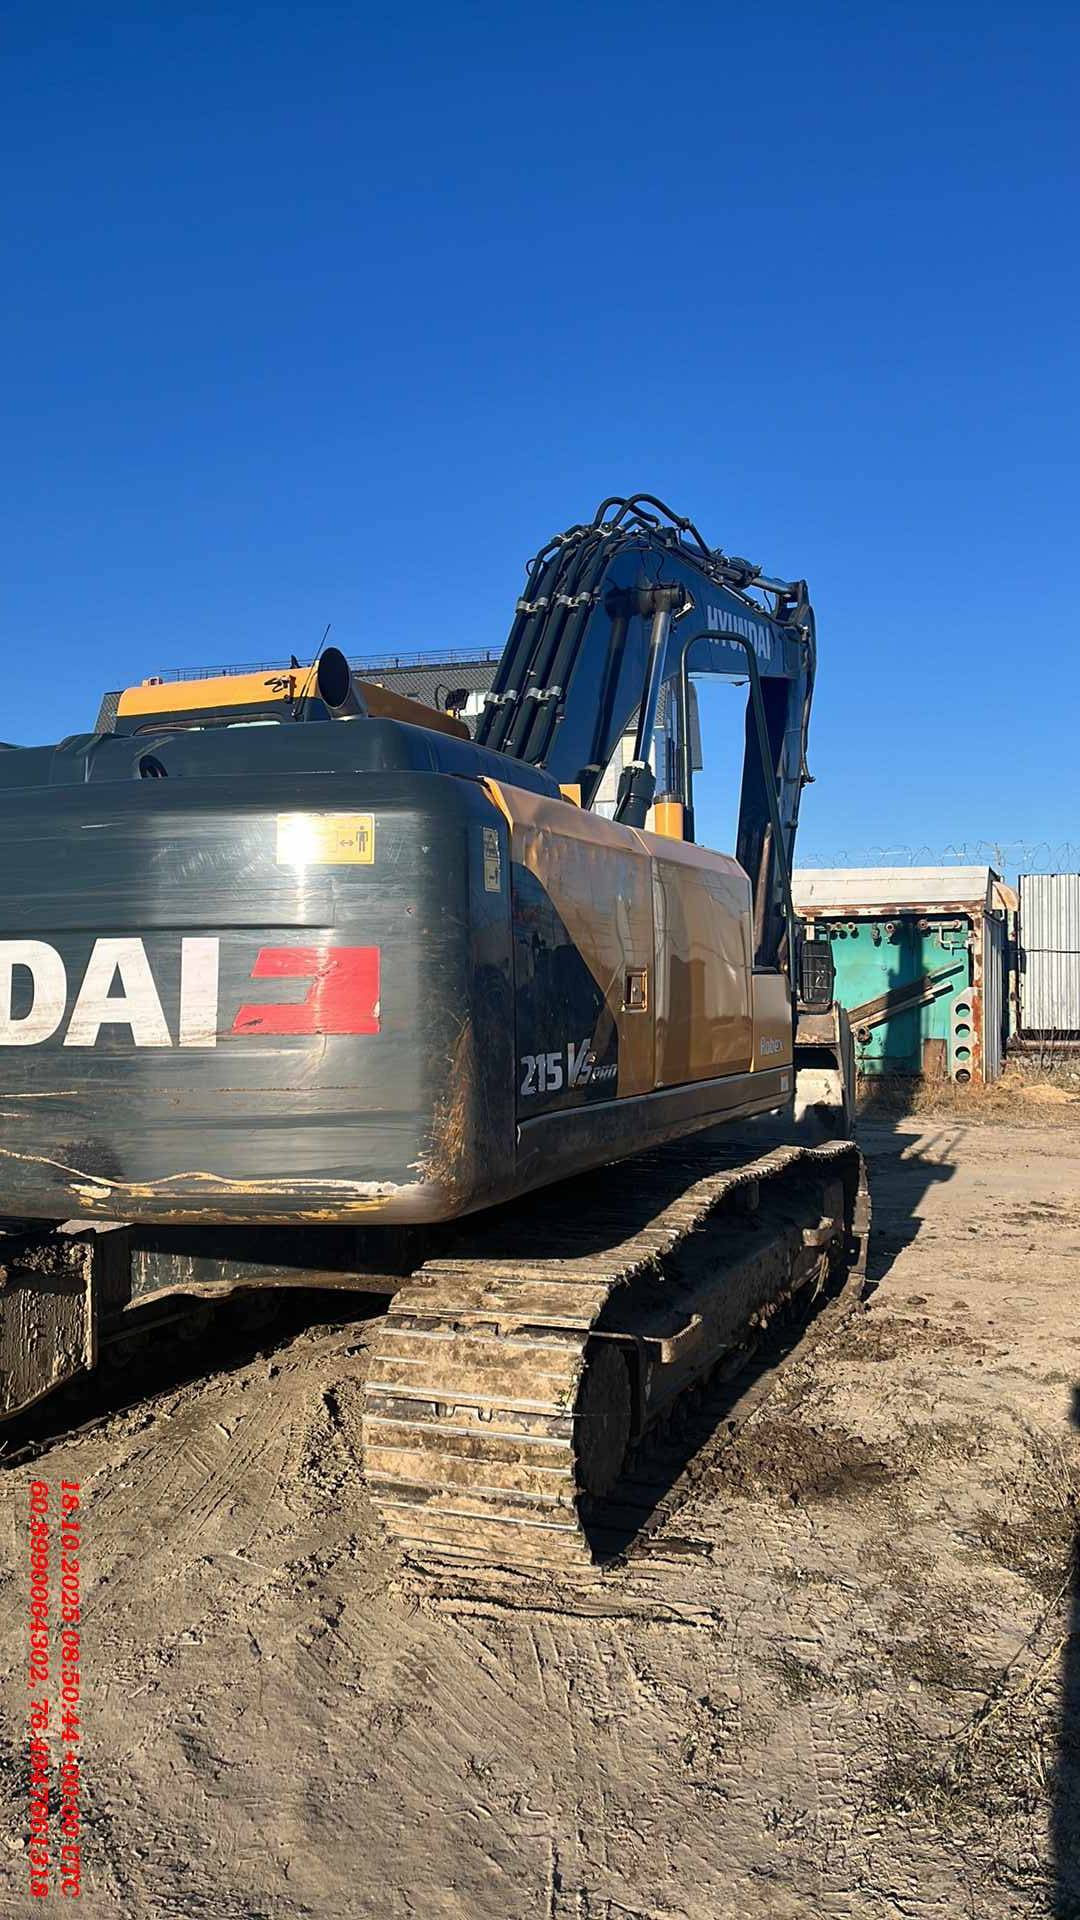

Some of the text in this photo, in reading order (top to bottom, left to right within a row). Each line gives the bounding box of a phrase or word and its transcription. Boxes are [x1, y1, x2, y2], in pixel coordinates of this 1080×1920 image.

[707, 605, 771, 660] HYUNDAI
[0, 937, 219, 1047] DAI
[520, 1052, 563, 1096] 215
